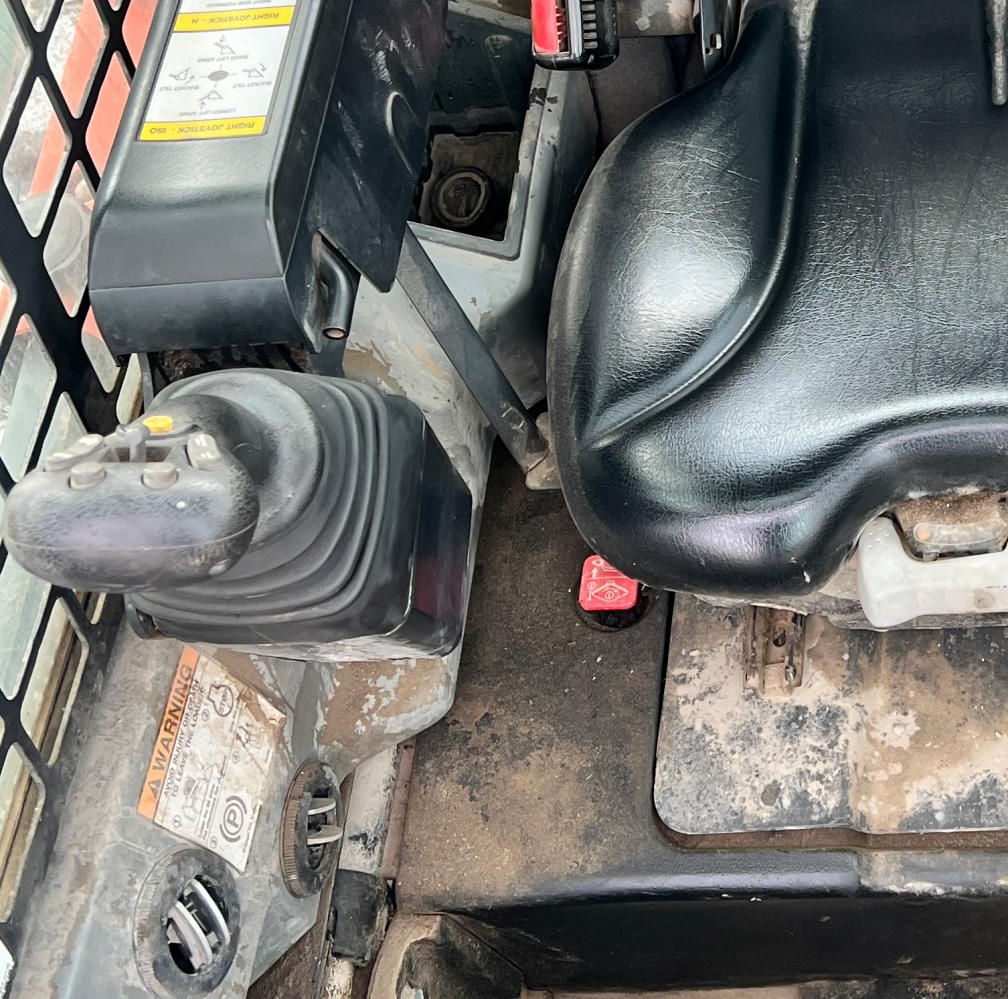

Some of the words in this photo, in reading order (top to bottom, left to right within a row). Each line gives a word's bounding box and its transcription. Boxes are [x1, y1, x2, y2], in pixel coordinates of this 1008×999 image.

[207, 15, 251, 23] JOYSTICK
[253, 12, 278, 20] RIGHT
[176, 124, 224, 133] JOYSTICK
[225, 121, 254, 130] RIGHT
[151, 663, 193, 774] WARNING
[162, 766, 175, 796] AVOID
[171, 729, 185, 764] INJURY
[182, 712, 190, 727] OR
[186, 678, 199, 710] DEATH
[171, 785, 178, 797] TO
[175, 750, 188, 782] LEAVE
[184, 728, 194, 748] THE
